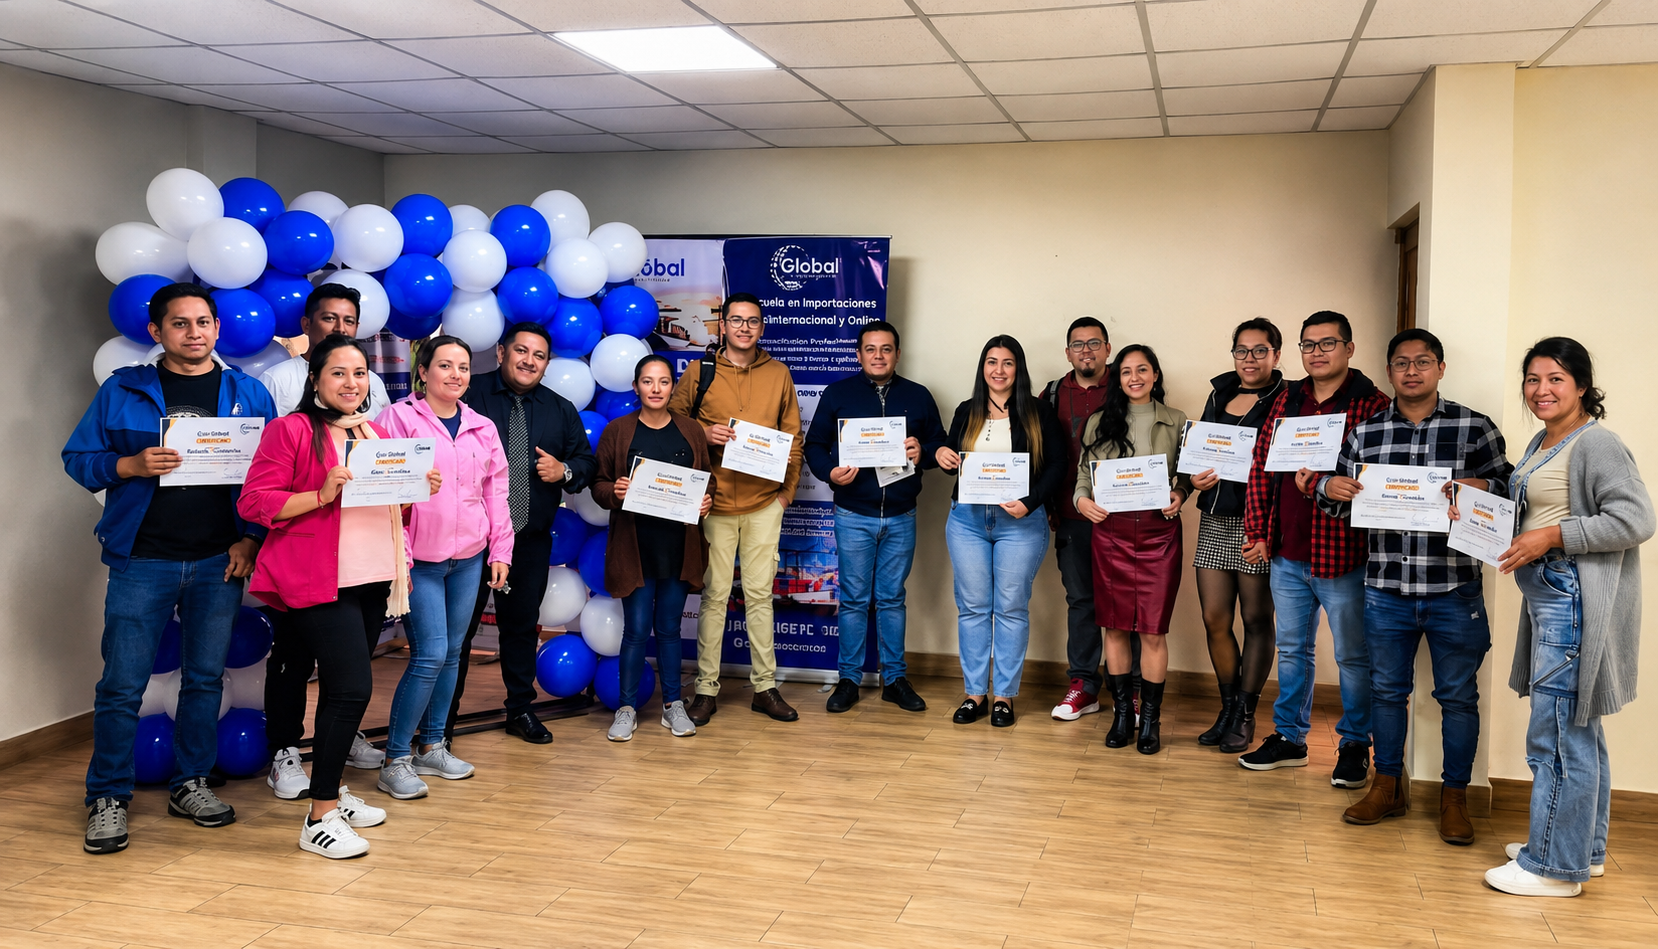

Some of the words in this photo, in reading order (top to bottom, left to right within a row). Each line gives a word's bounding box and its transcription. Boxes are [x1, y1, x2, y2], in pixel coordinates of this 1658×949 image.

[781, 257, 839, 274] Global
[759, 297, 785, 307] cuela
[788, 299, 800, 308] en
[803, 298, 877, 310] Importaciones
[839, 316, 845, 327] y
